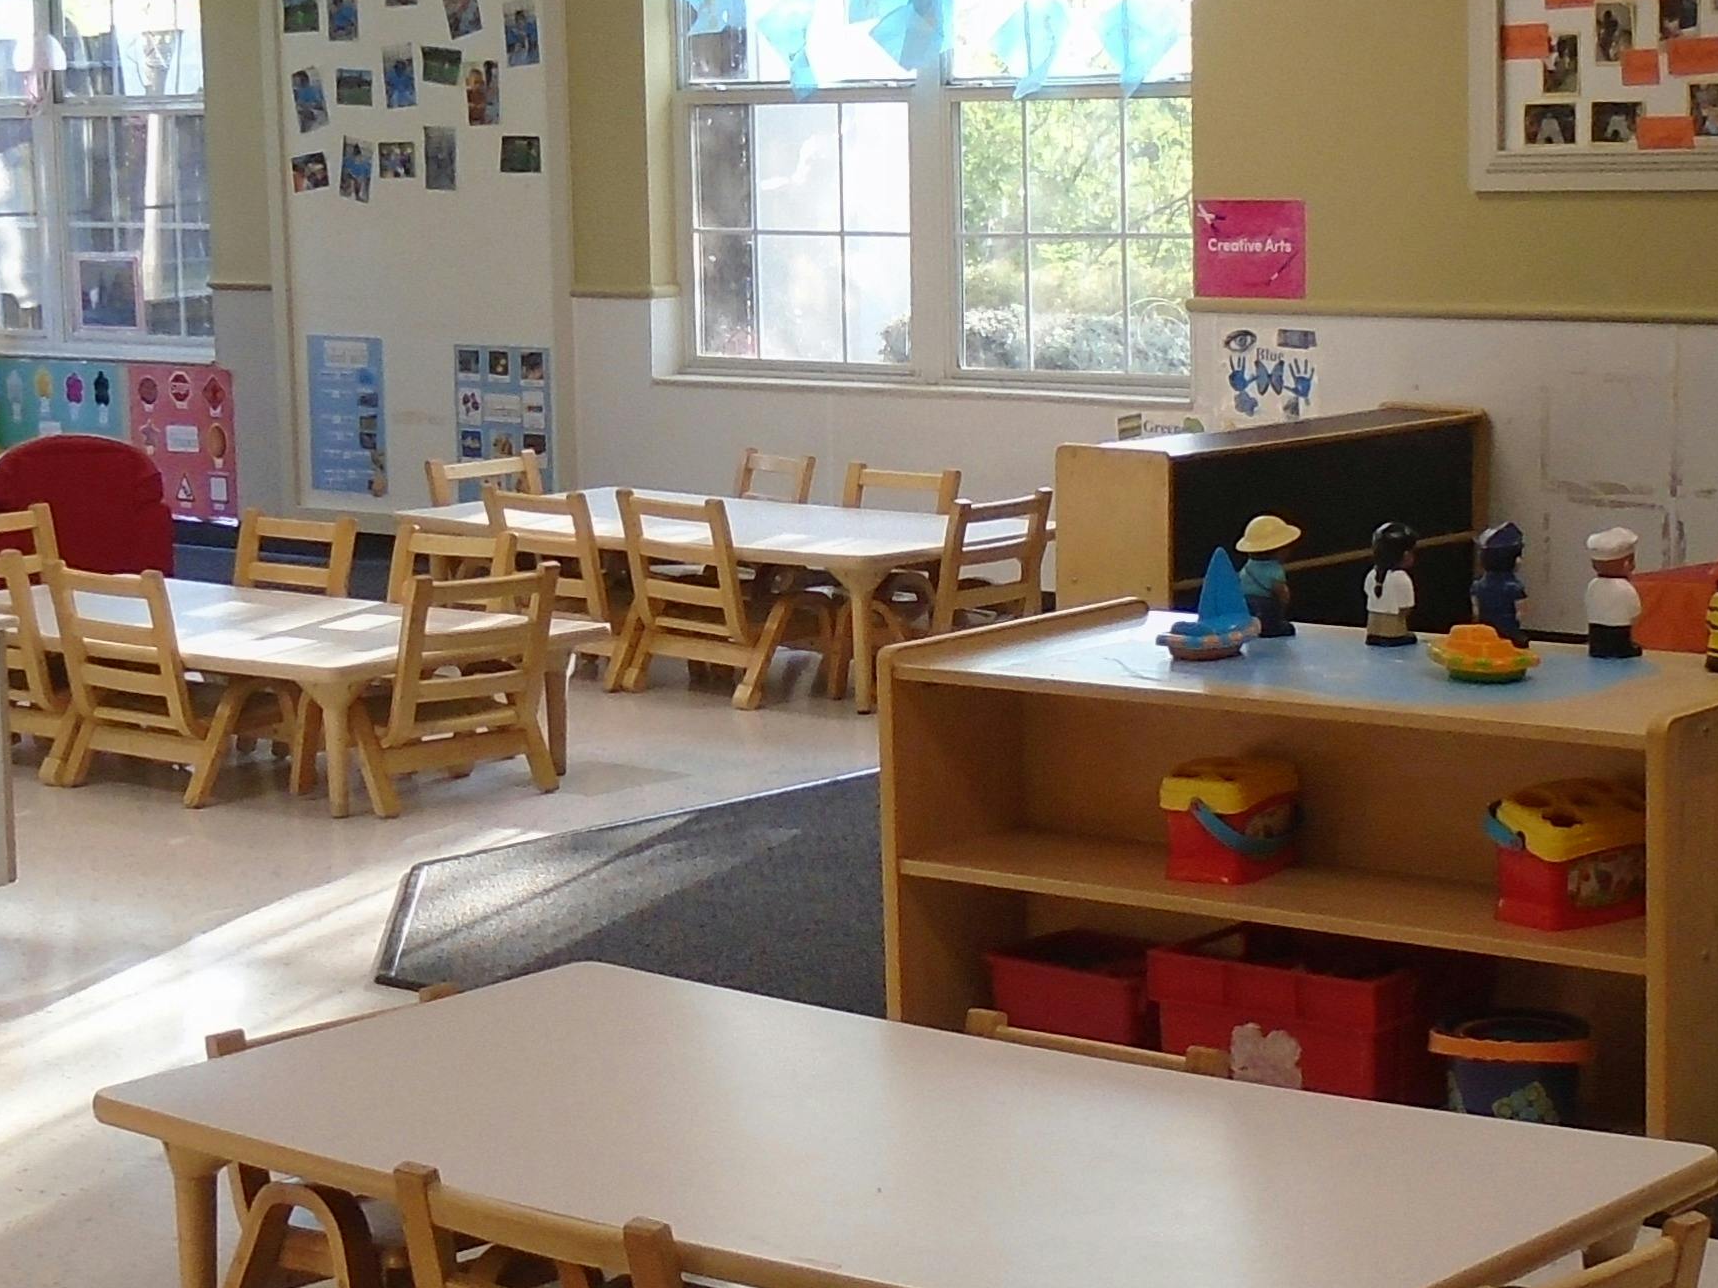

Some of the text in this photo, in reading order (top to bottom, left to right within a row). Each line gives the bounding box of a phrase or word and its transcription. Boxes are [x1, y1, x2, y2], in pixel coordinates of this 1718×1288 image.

[1207, 236, 1292, 253] Creative Arts
[1255, 347, 1284, 362] Blue
